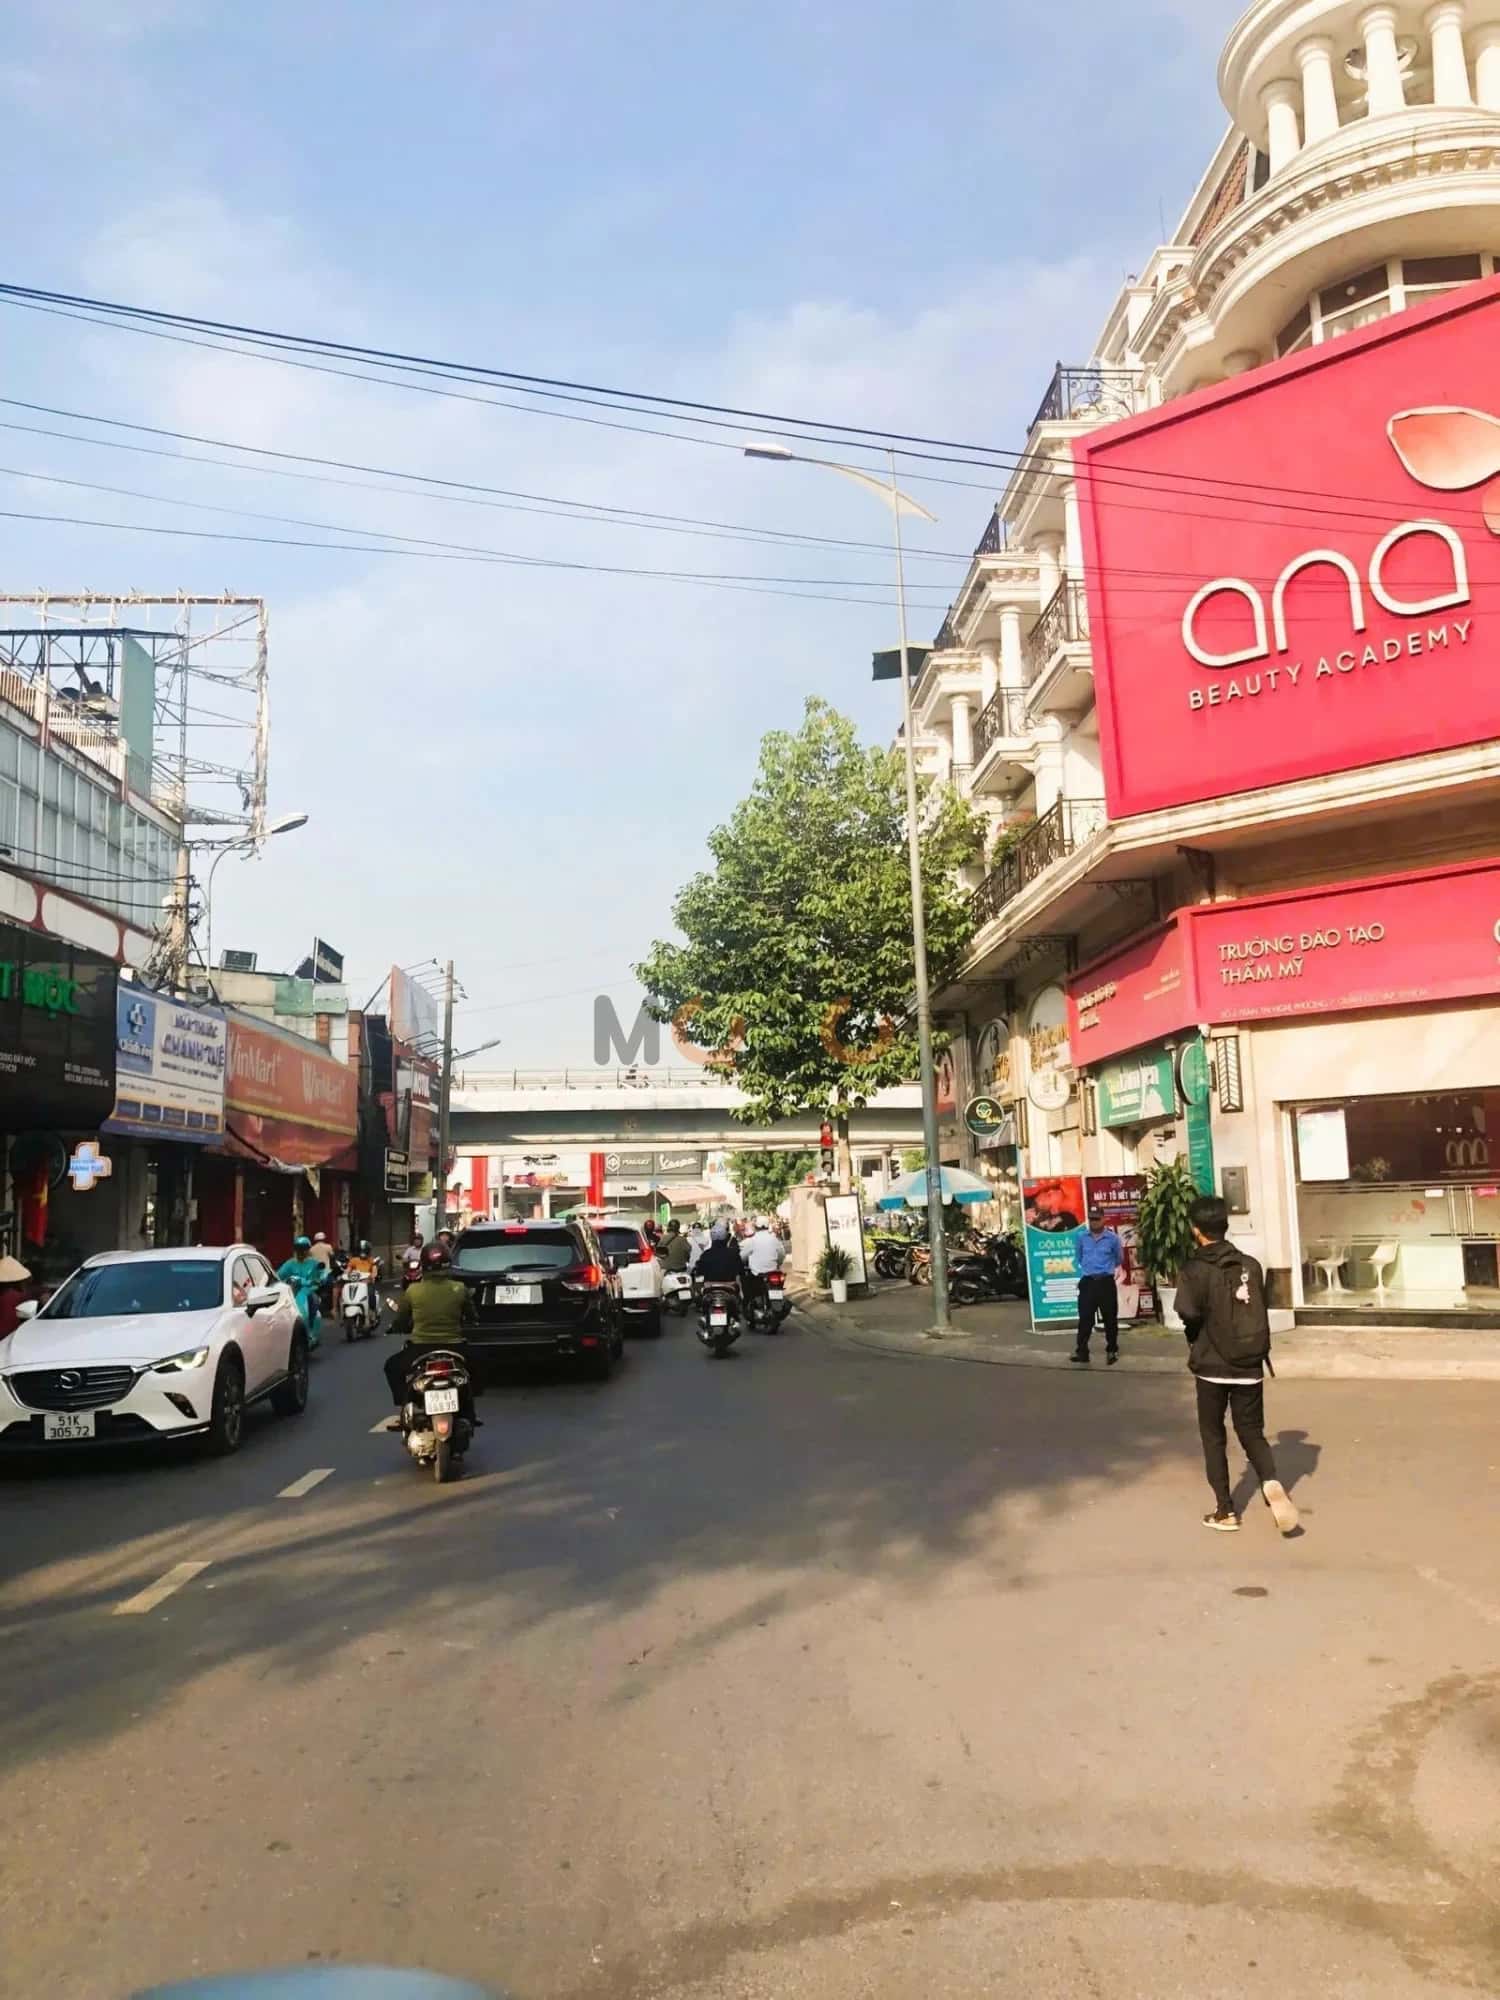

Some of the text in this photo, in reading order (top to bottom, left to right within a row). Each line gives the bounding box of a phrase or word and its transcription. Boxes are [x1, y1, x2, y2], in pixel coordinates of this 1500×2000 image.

[1181, 518, 1471, 668] ana
[1188, 619, 1473, 711] BEAUTY ACADEMY
[1347, 923, 1385, 946] TẠO
[50, 1425, 90, 1439] 305.72
[58, 1415, 80, 1427] 51K
